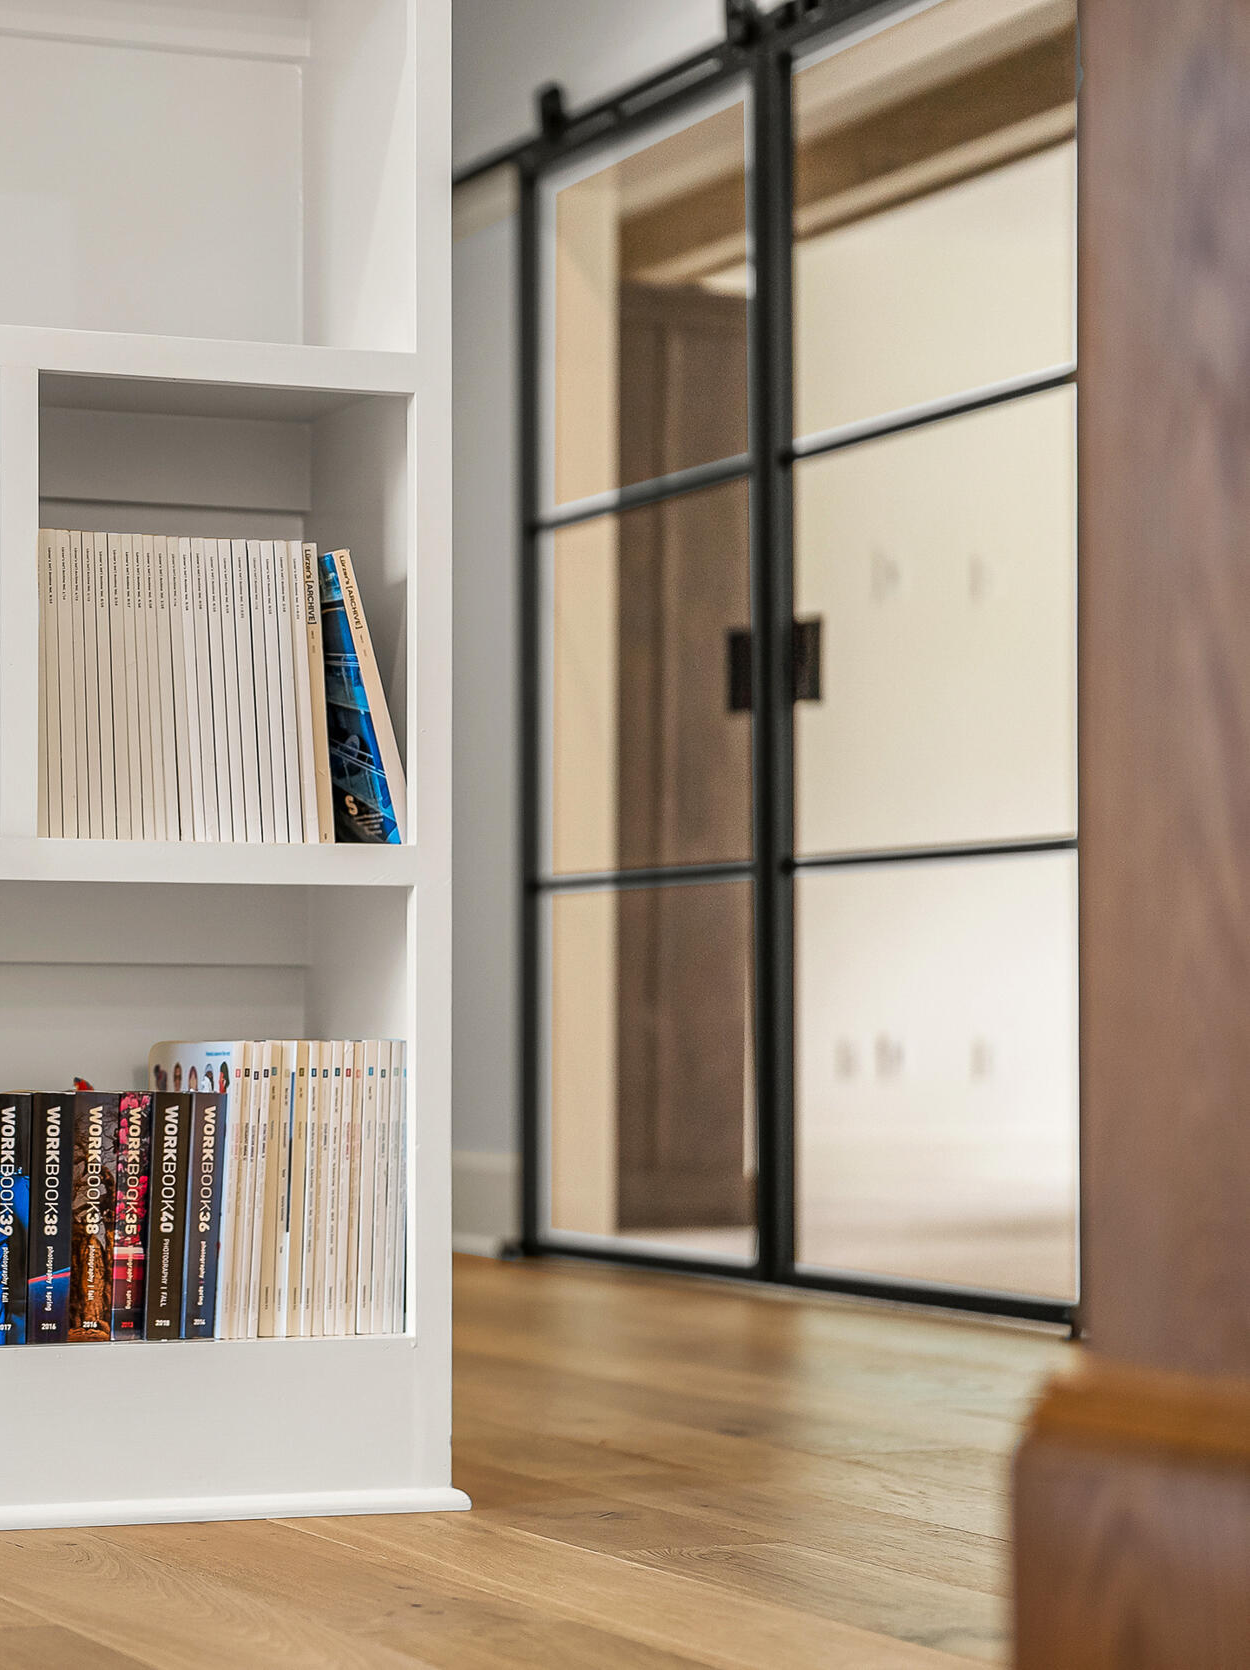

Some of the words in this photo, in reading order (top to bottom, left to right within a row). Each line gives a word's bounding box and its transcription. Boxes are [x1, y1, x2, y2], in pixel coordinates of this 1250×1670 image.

[44, 1106, 61, 1236] WORKBOOK38
[86, 1106, 103, 1235] WORKBOOK38
[125, 1107, 141, 1235] WORKBOOK35
[160, 1105, 179, 1233] WORKBOOK40
[199, 1106, 217, 1232] WORKBOOK36
[1, 1246, 9, 1286] photography
[46, 1246, 54, 1284] photography
[161, 1238, 170, 1284] PHOTOGRAPHY
